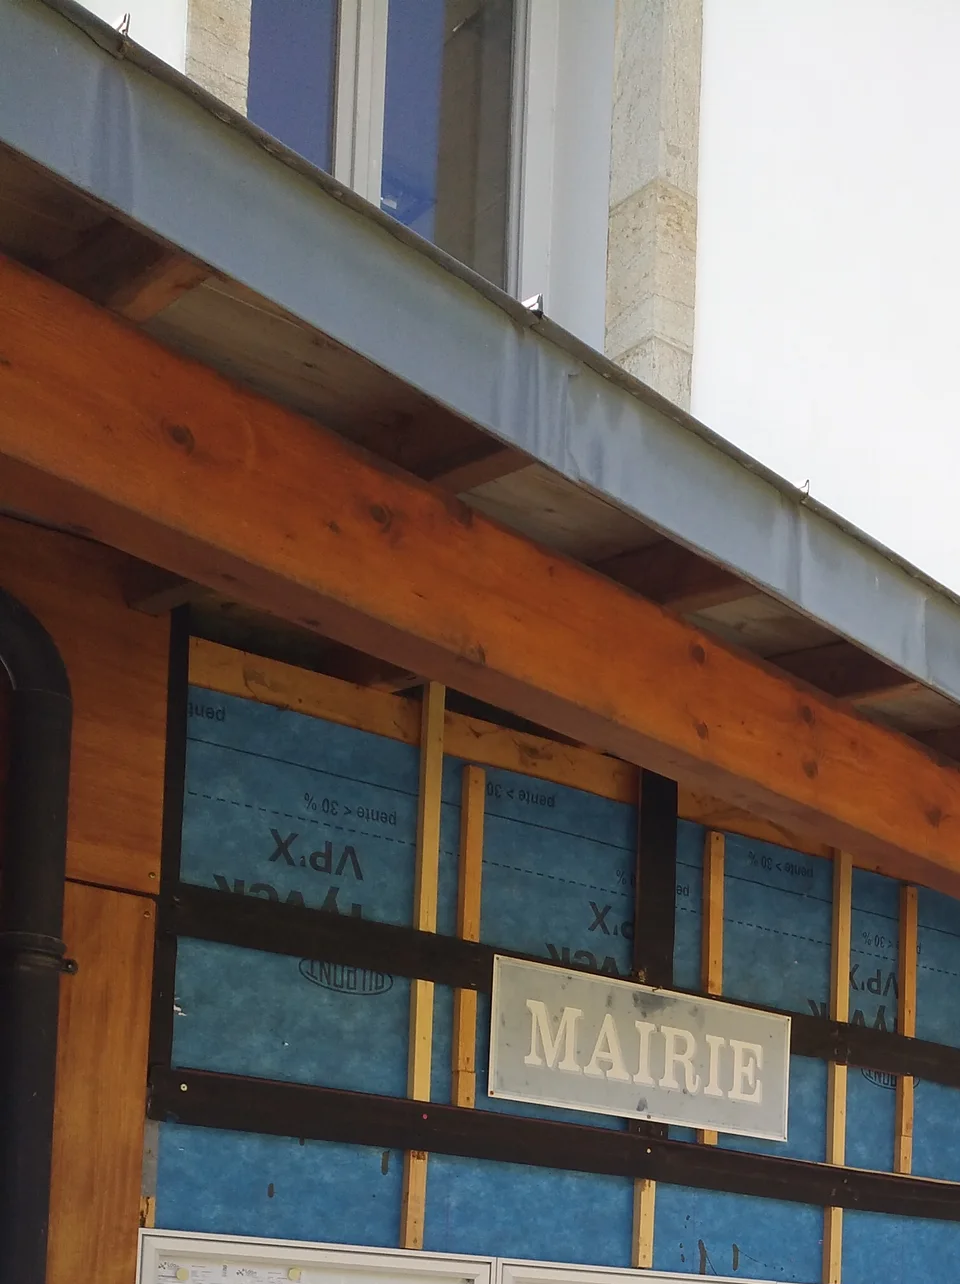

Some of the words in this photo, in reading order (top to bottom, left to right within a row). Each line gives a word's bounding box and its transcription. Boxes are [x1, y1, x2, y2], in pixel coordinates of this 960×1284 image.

[321, 798, 339, 816] 30
[518, 787, 556, 808] pente
[357, 806, 397, 826] pente
[524, 998, 765, 1104] MAIRIE
